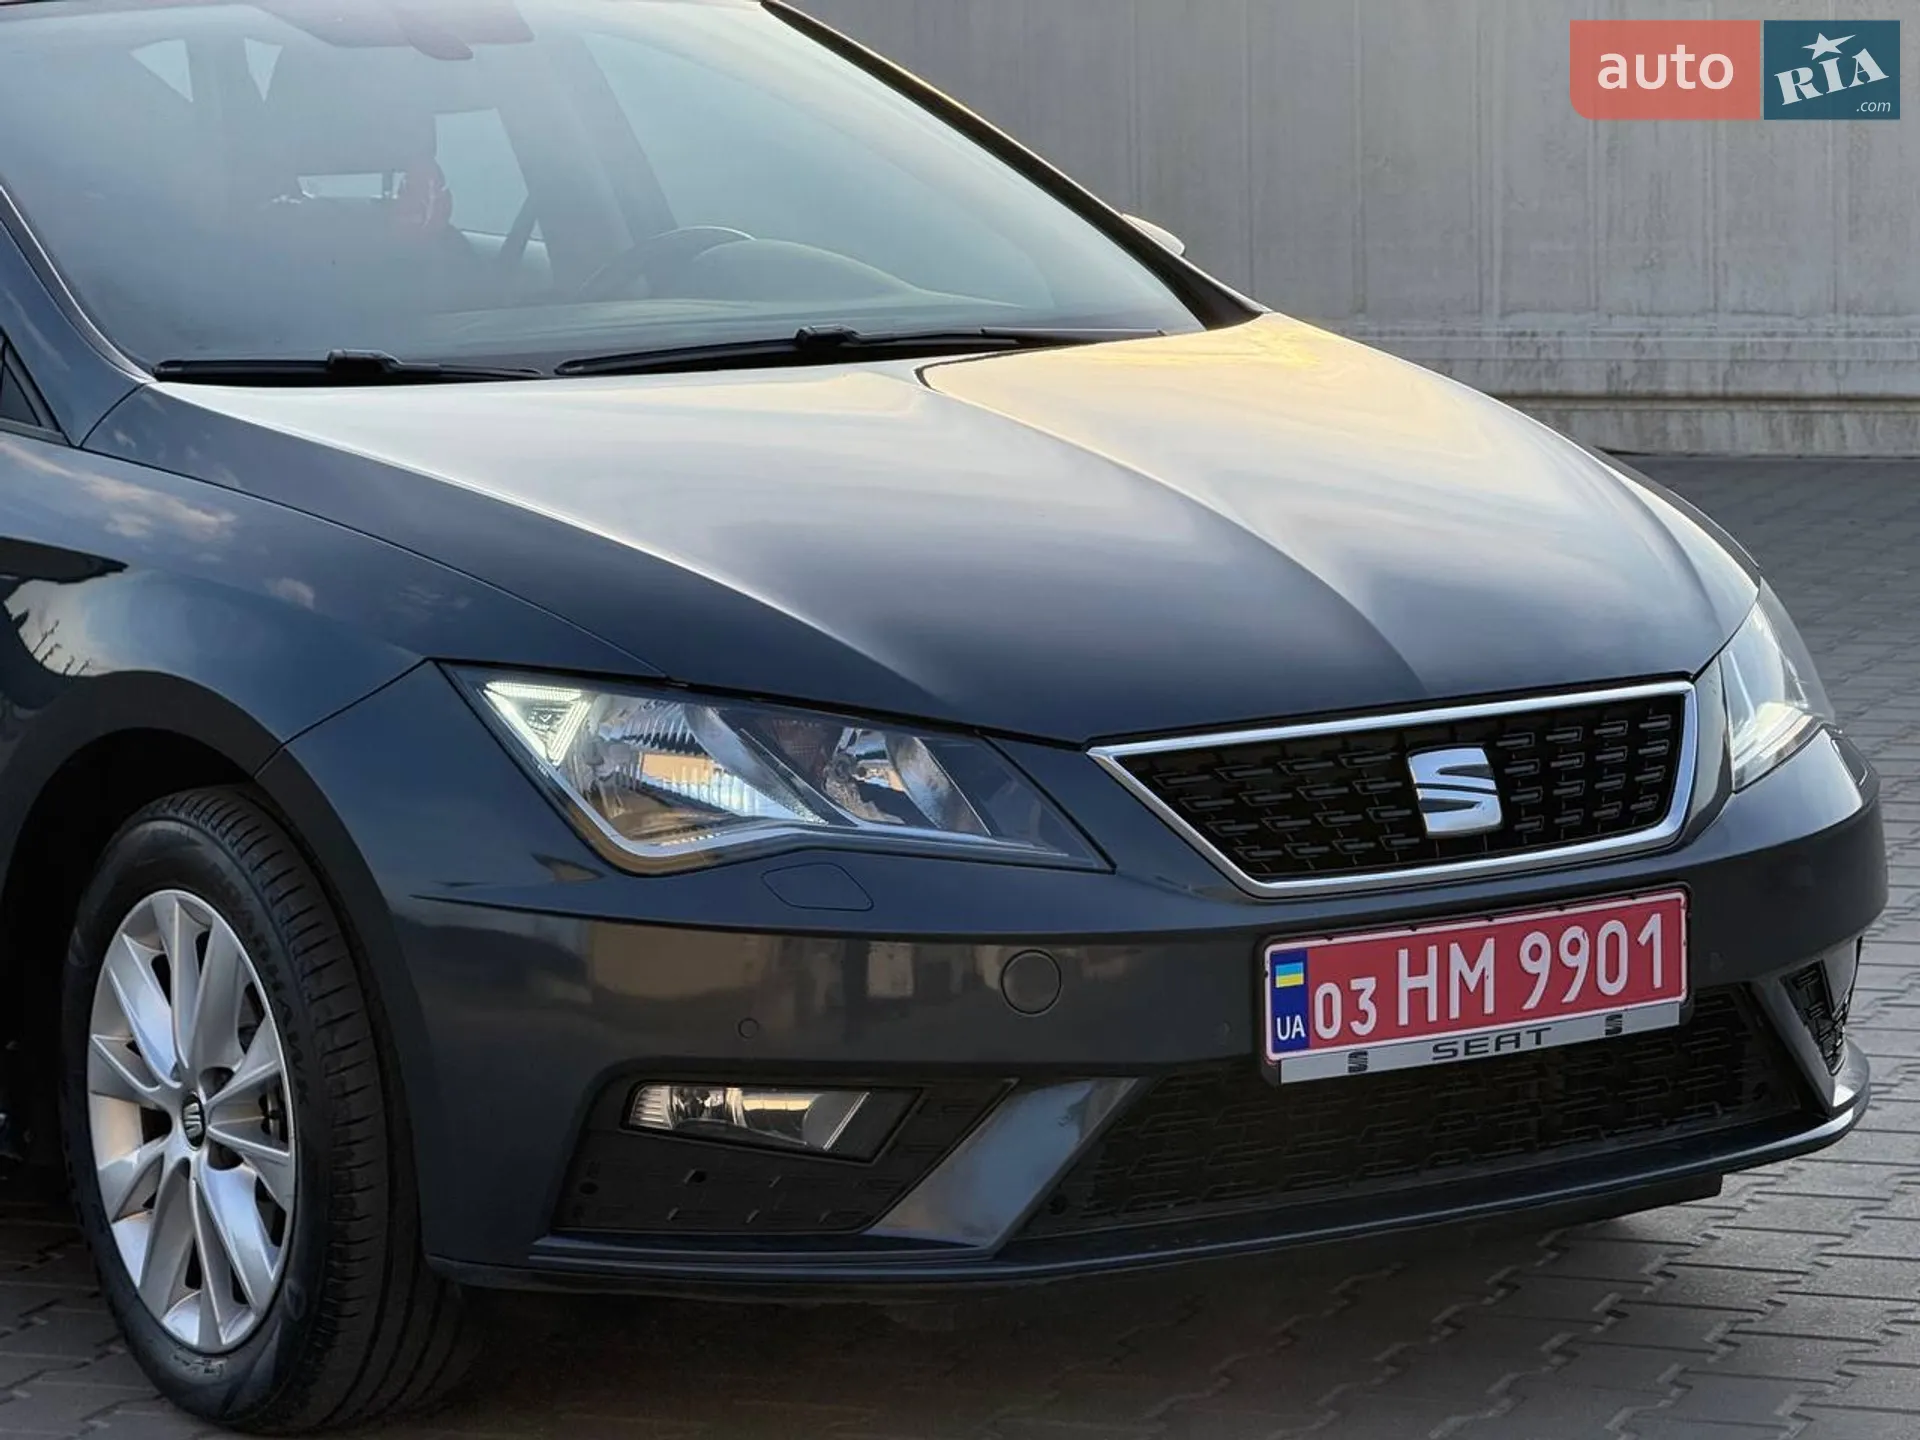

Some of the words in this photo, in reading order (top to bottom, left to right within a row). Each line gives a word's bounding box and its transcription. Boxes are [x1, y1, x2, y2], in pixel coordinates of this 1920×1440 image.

[1313, 976, 1377, 1039] 03
[1397, 936, 1496, 1026] HM
[1518, 912, 1664, 1011] 9901
[1276, 1014, 1306, 1042] UA
[1431, 1026, 1552, 1061] SEAT
